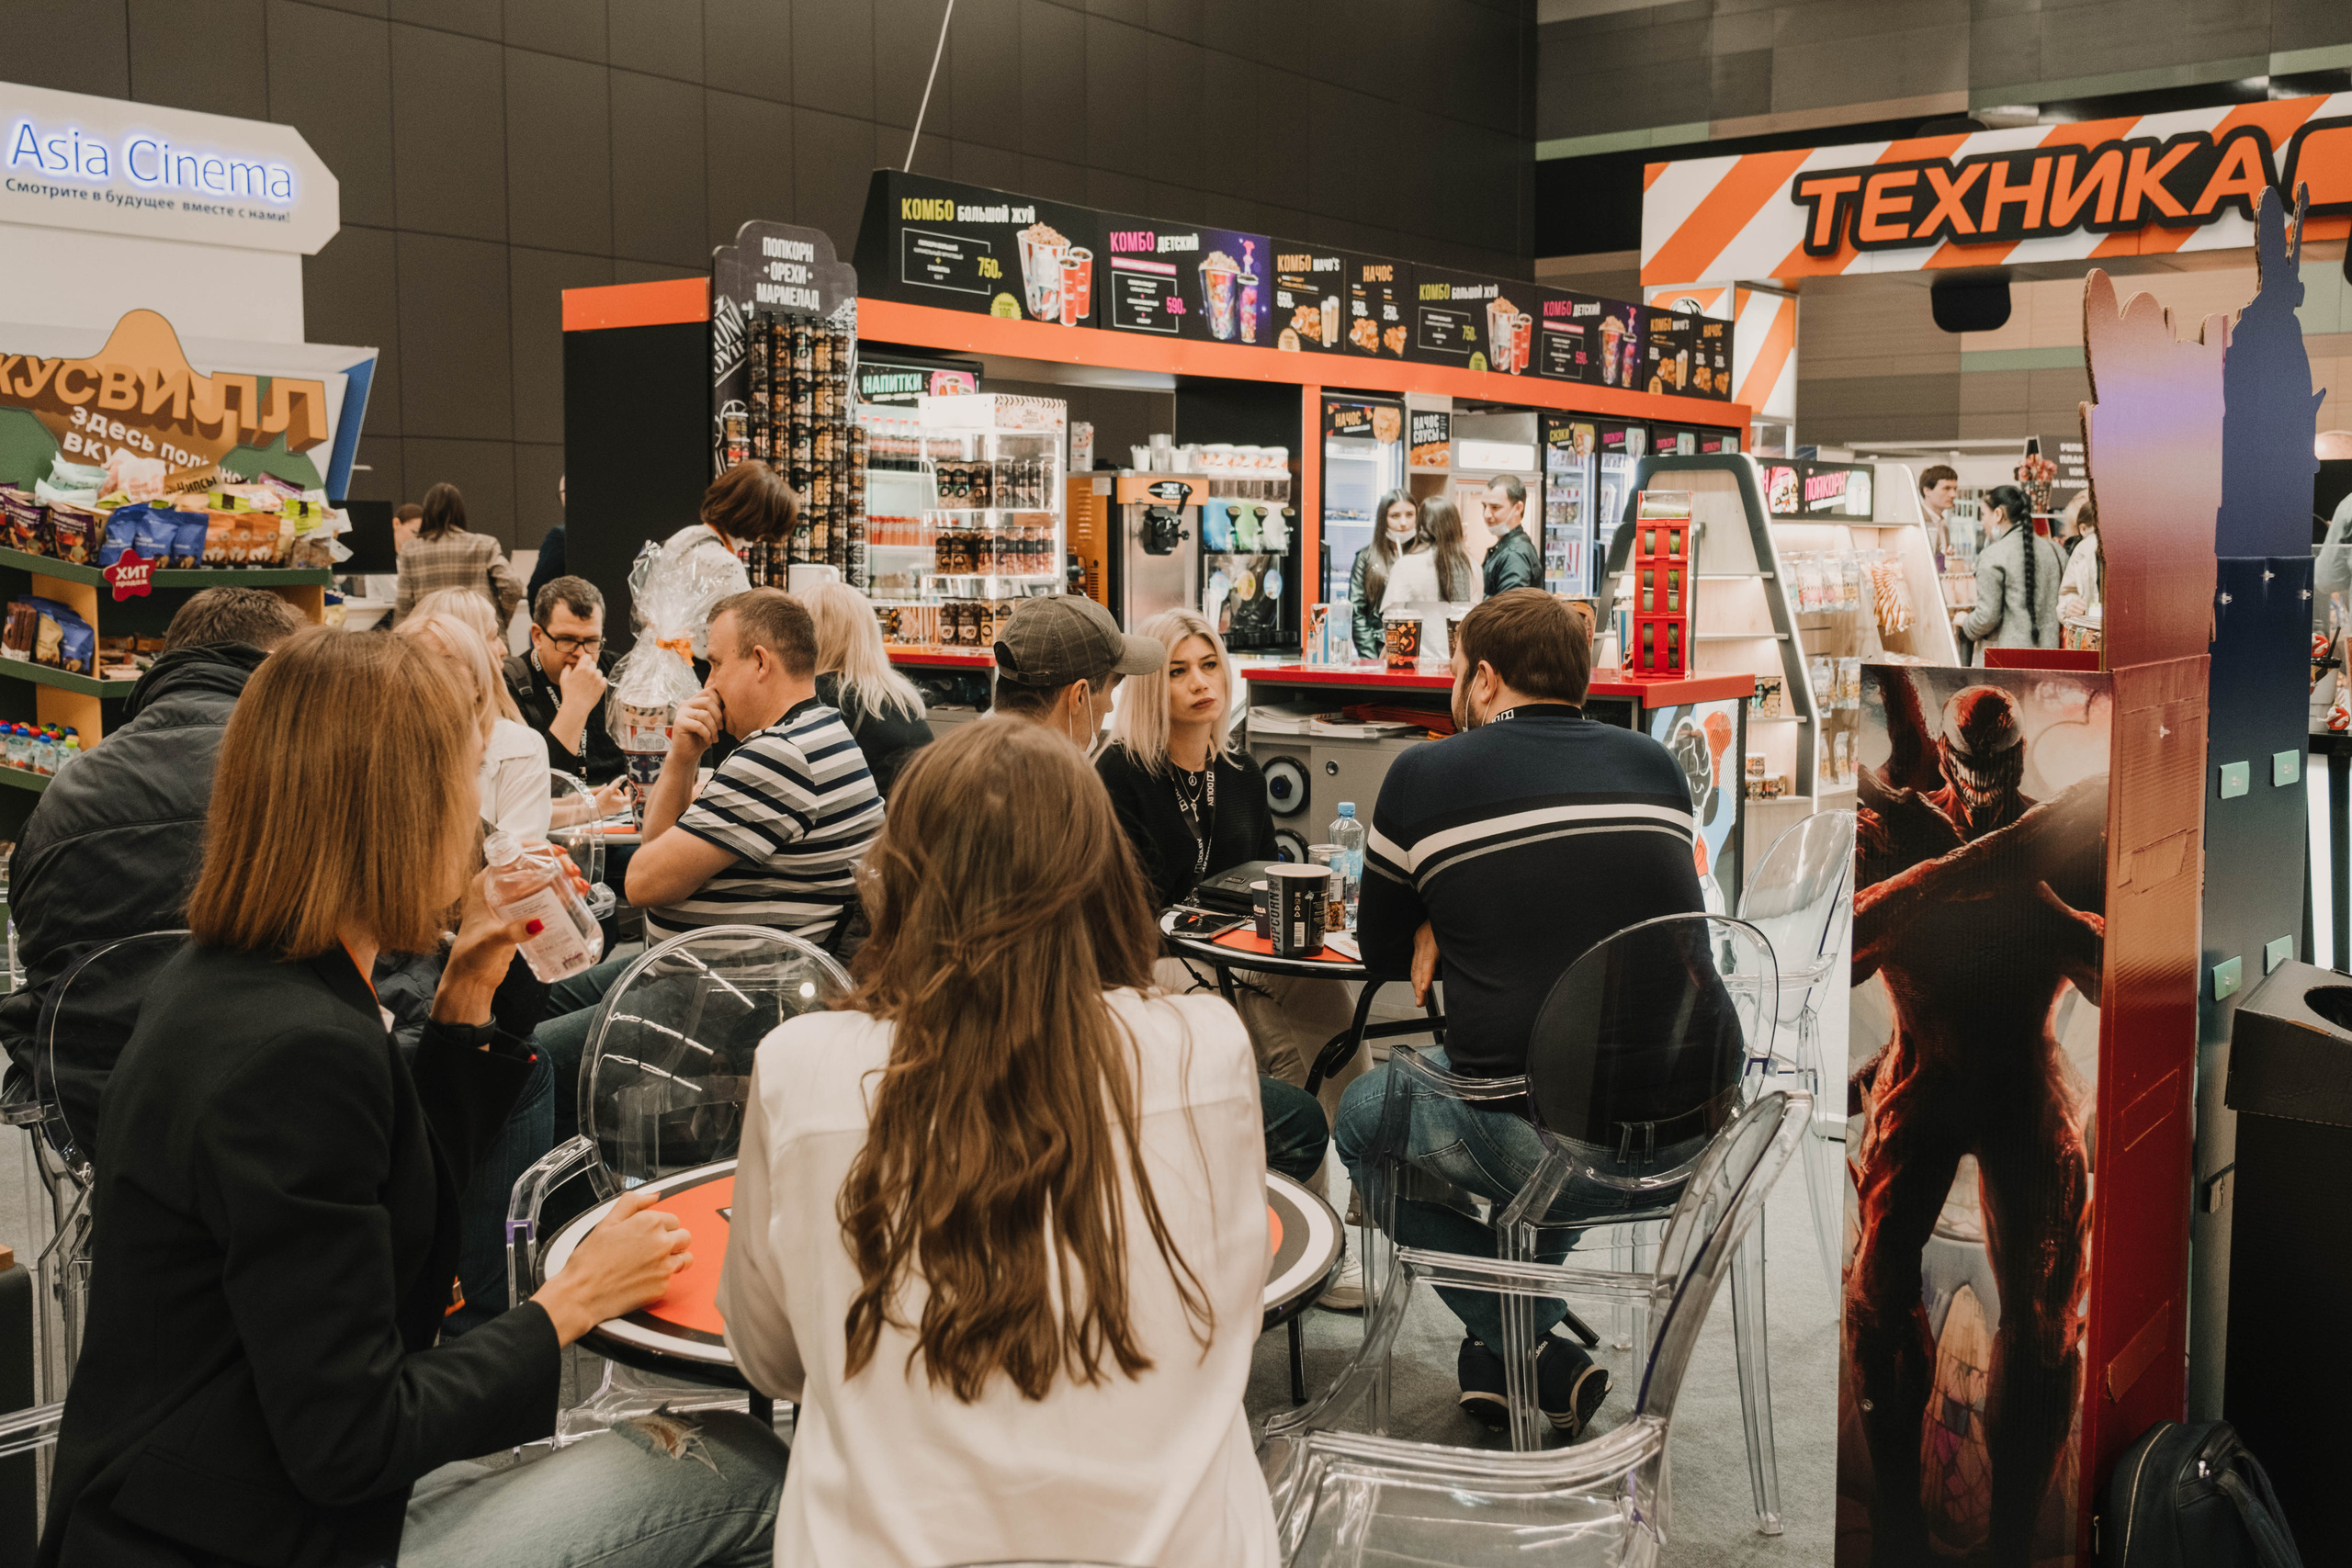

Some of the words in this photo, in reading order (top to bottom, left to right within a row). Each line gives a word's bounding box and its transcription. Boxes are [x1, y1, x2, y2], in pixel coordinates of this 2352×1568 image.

[11, 123, 109, 178] Asia
[128, 139, 292, 199] Cinema
[6, 177, 88, 200] Смотрите
[93, 191, 101, 201] в
[106, 189, 175, 210] будущее
[182, 200, 234, 218] вместе
[1799, 135, 2268, 247] ТЕХНИКА
[901, 197, 955, 221] КОМБО
[956, 204, 1010, 223] БОЛЬШОЙ
[1011, 205, 1036, 224] ЖУЙ
[762, 235, 814, 264] ПОПКОРН
[1109, 231, 1155, 253] КОМБО
[1156, 232, 1200, 254] ДЕТСКИЙ
[769, 261, 807, 286] ОРЕХИ
[1276, 254, 1313, 273] КОМБО
[1363, 265, 1394, 283] НАЧОС
[755, 282, 820, 312] МАРМЕЛАД
[1419, 283, 1451, 301] КОМБО
[1451, 284, 1484, 300] БОЛЬШОЙ
[1543, 299, 1573, 317] КОМБО
[1572, 301, 1601, 318] ДЕТСКИЙ
[1649, 317, 1673, 333] КОМБО
[1702, 323, 1724, 338] НАЧОС
[862, 373, 923, 394] НАПИТКИ
[1335, 411, 1362, 427] НАЧОС
[1412, 413, 1440, 430] НАЧОС
[1412, 428, 1440, 444] СОУСЫ
[1804, 470, 1846, 502] ПОПКОРН
[115, 564, 150, 581] ХИТ
[1206, 782, 1215, 807] DOLBY
[1196, 837, 1204, 863] DOLBY
[1270, 891, 1282, 953] POPCORN
